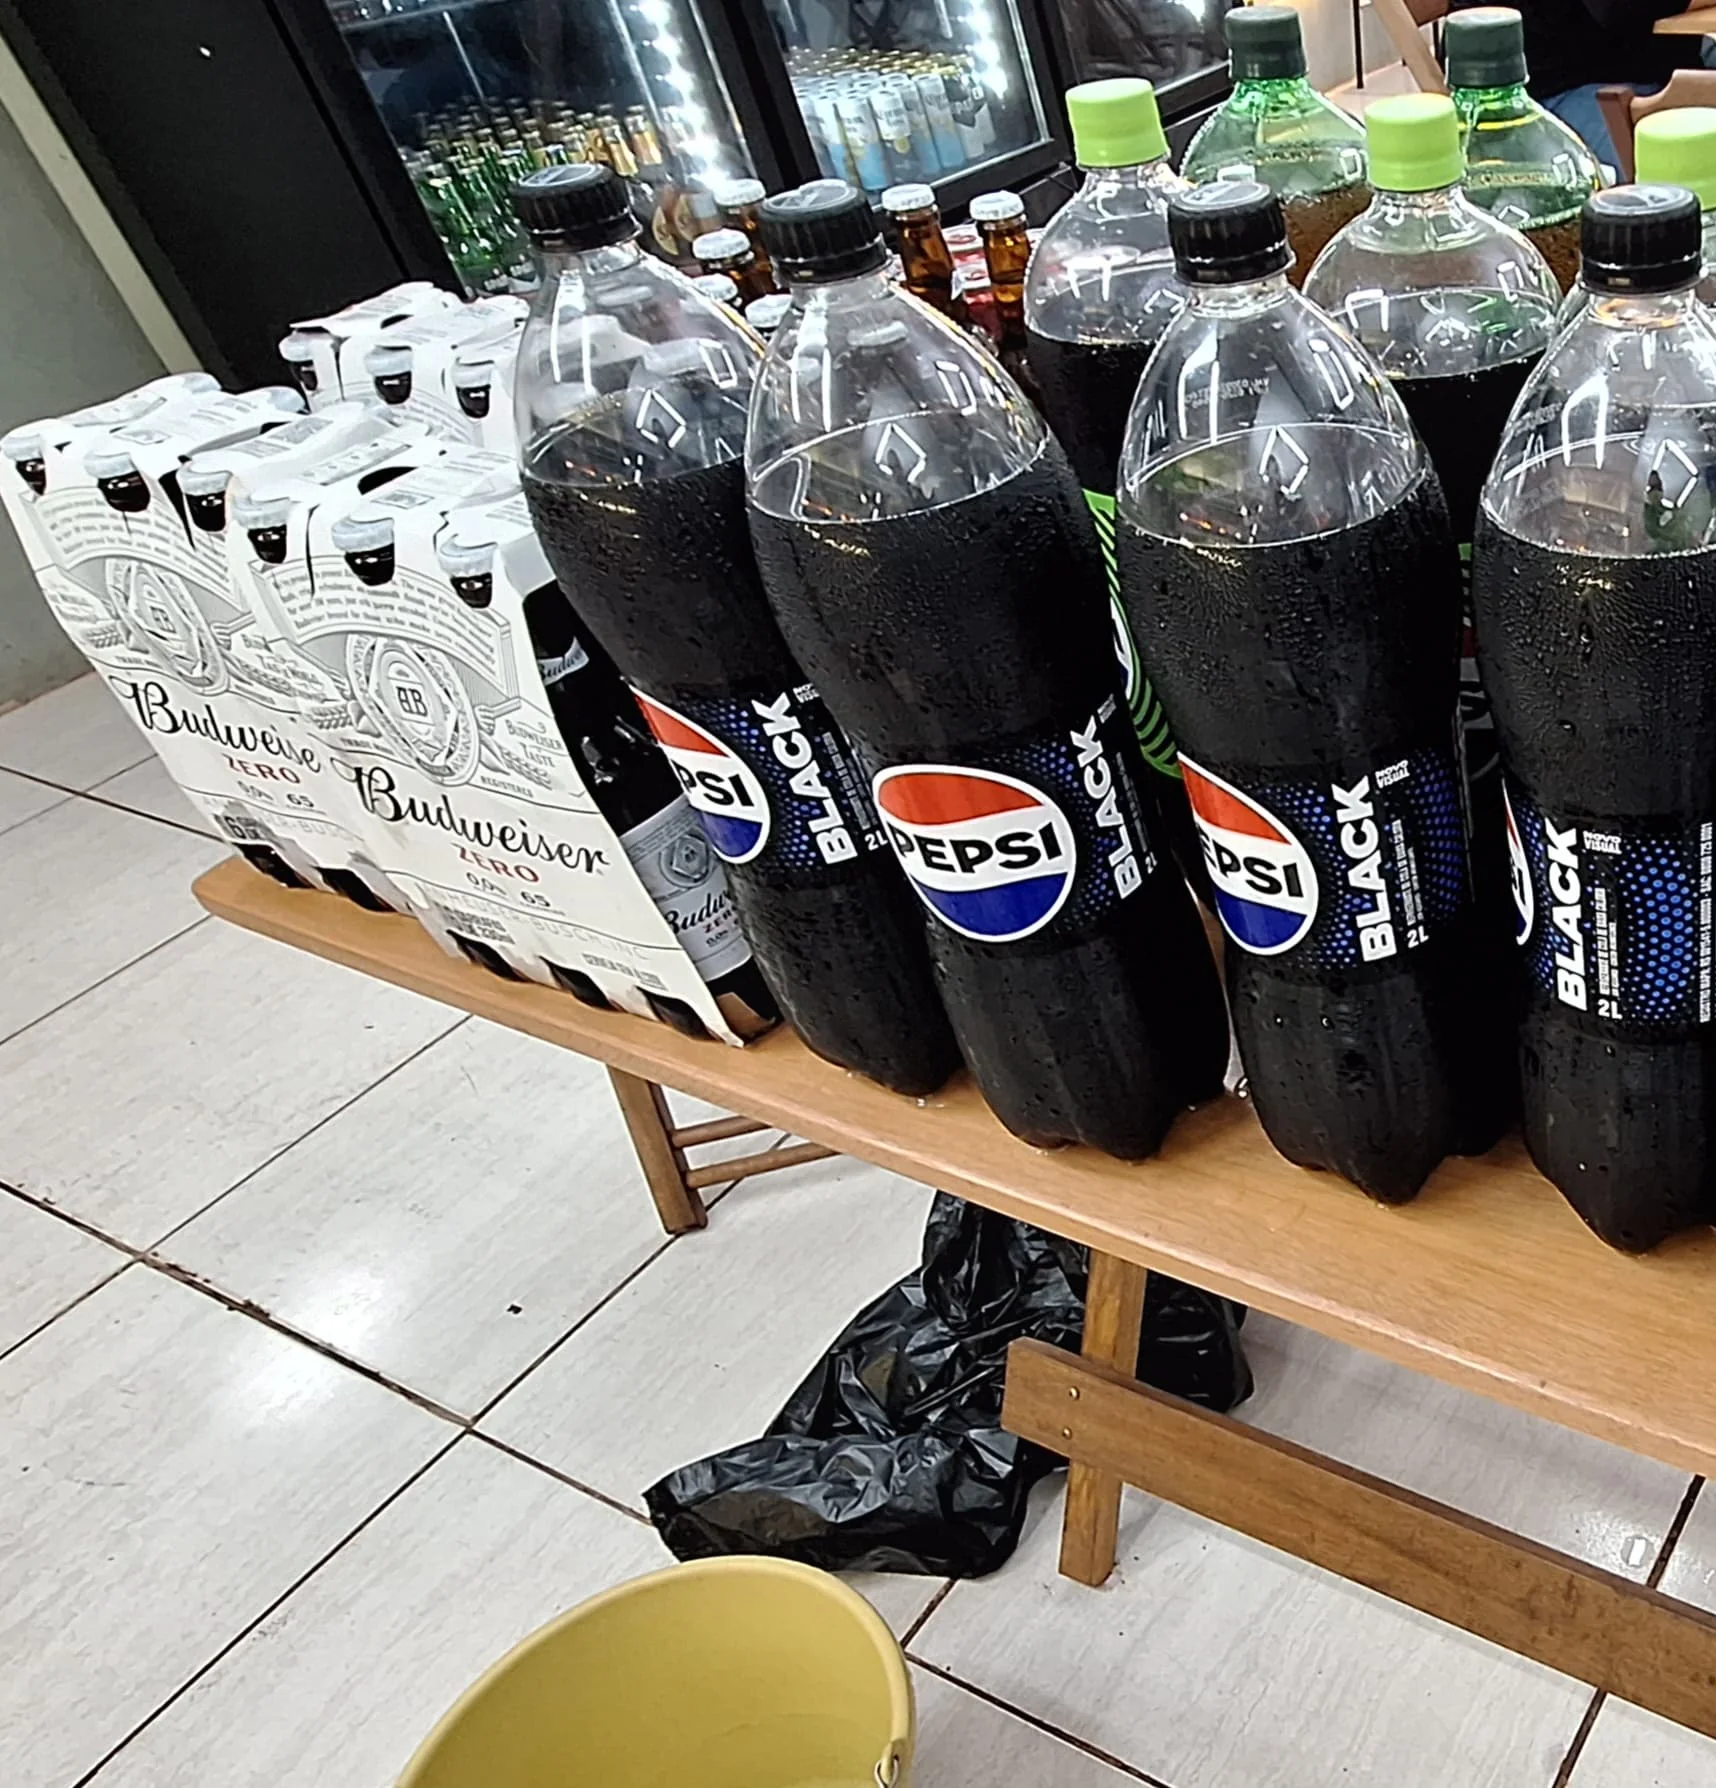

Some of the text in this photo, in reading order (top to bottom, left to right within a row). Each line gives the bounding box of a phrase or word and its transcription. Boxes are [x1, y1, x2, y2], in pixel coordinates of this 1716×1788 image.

[107, 674, 321, 773] Budweise
[222, 753, 301, 785] ZERO
[671, 759, 755, 807] PSI
[751, 691, 858, 865] BLACK
[331, 756, 610, 876] Budweiser
[1070, 715, 1142, 899] BLACK
[451, 842, 541, 883] ZERO
[864, 830, 888, 851] 2L
[887, 820, 1063, 875] PEPSI
[1201, 828, 1304, 898] PSI
[1583, 830, 1622, 844] NOVO
[1331, 775, 1397, 963] BLACK
[1407, 925, 1429, 949] 2L
[1544, 817, 1588, 1012] BLACK
[1598, 999, 1623, 1020] 2L
